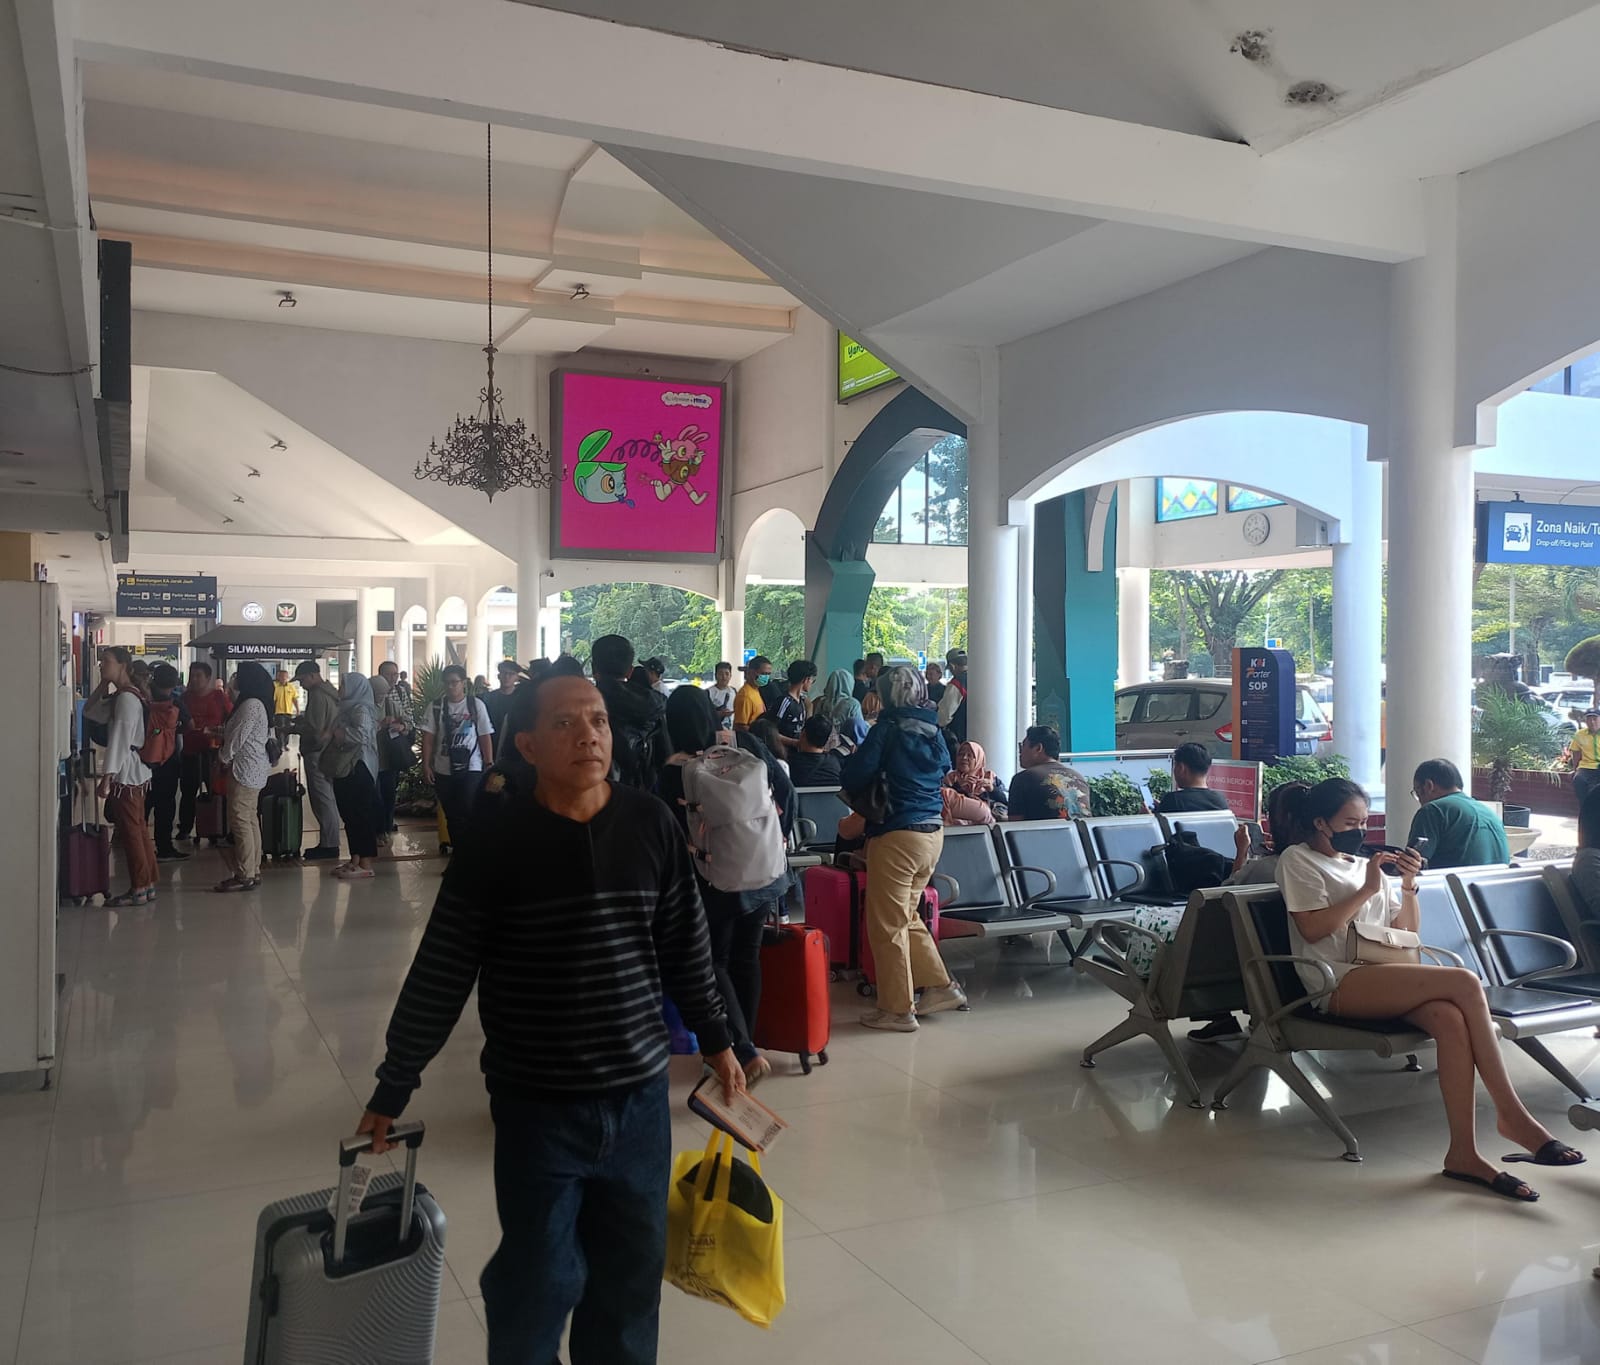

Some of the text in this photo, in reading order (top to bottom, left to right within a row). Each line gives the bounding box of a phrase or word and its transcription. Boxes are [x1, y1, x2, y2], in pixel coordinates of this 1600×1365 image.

[1536, 520, 1562, 533] Zona
[228, 645, 276, 654] SILIWANGI
[1248, 681, 1268, 691] SOP
